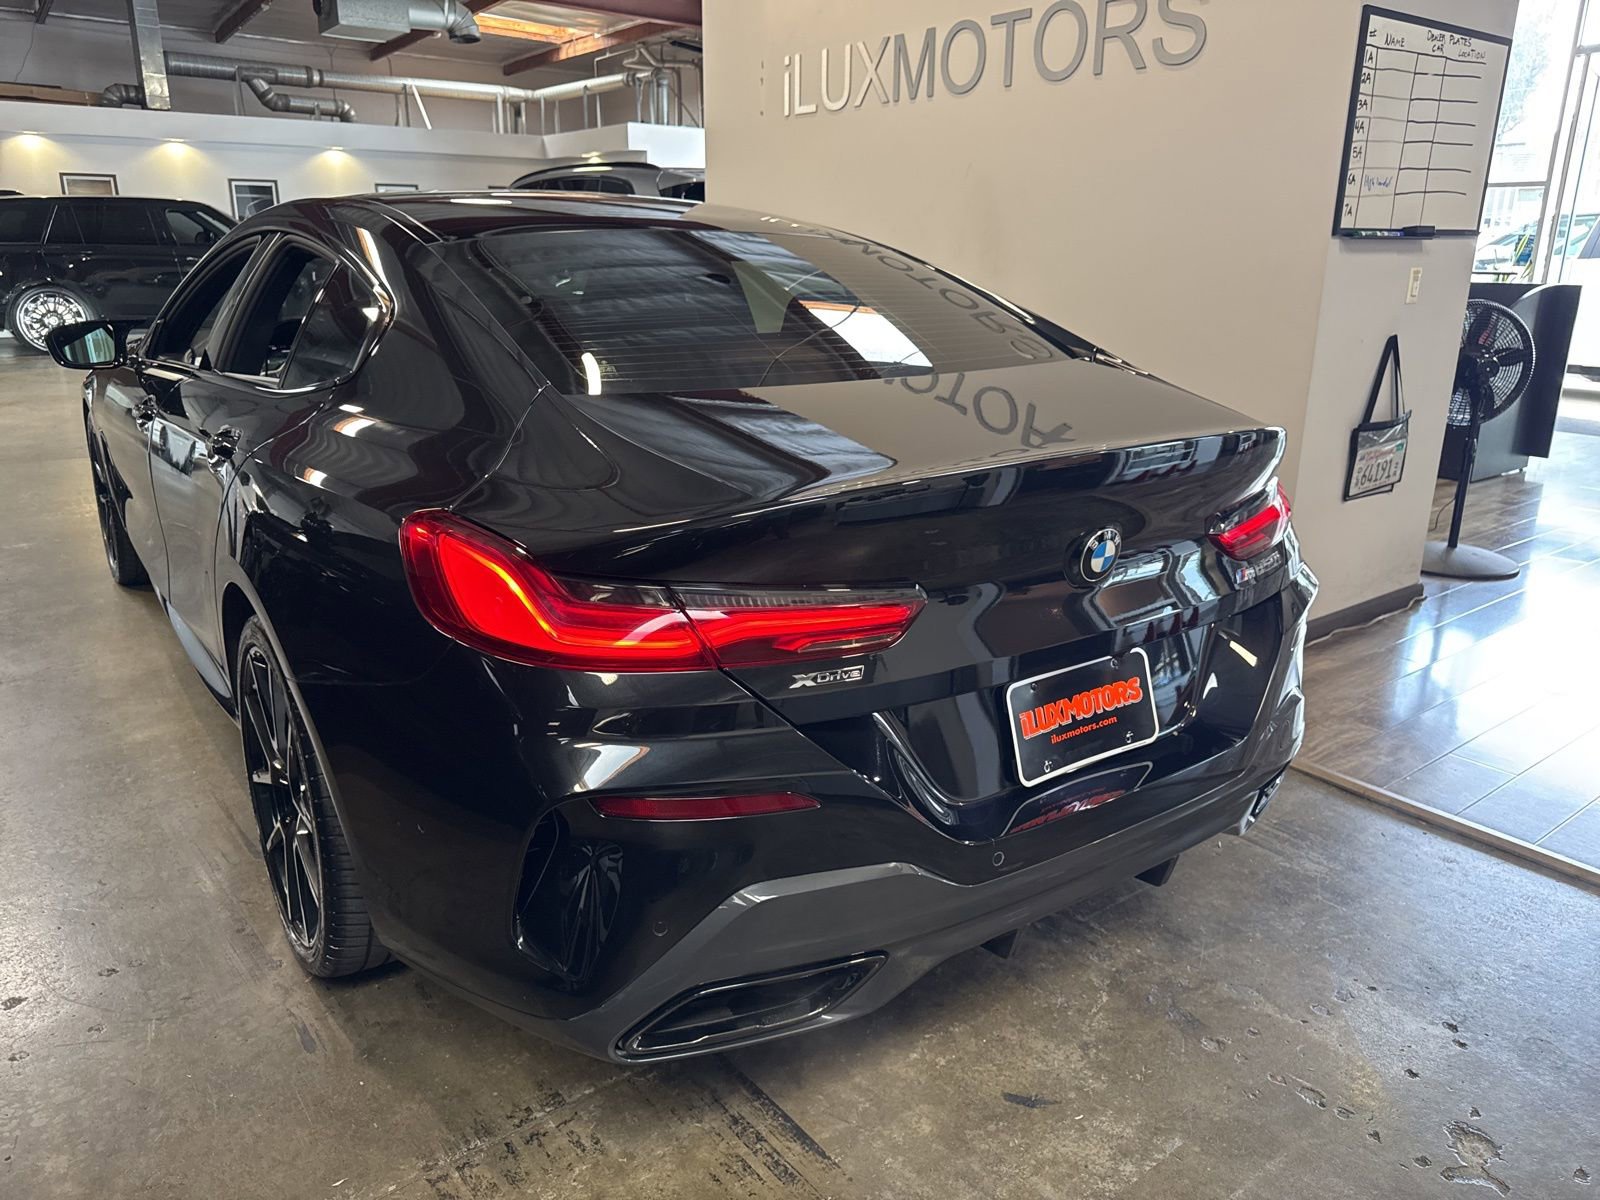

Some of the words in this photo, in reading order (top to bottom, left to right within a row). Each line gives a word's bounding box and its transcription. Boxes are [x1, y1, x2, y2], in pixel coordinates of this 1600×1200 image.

[1384, 32, 1405, 47] NAME
[1431, 43, 1445, 55] CAR
[1449, 34, 1472, 48] PLATES
[783, 0, 1208, 118] iLUXMOTORS
[1361, 72, 1371, 85] 2A
[1358, 98, 1368, 111] 3A
[1354, 119, 1365, 135] 4A
[1348, 172, 1356, 186] 6A
[1344, 202, 1353, 217] 7A
[1019, 676, 1144, 740] iLUXMOTORS
[1051, 715, 1118, 744] iluxmotors.com
